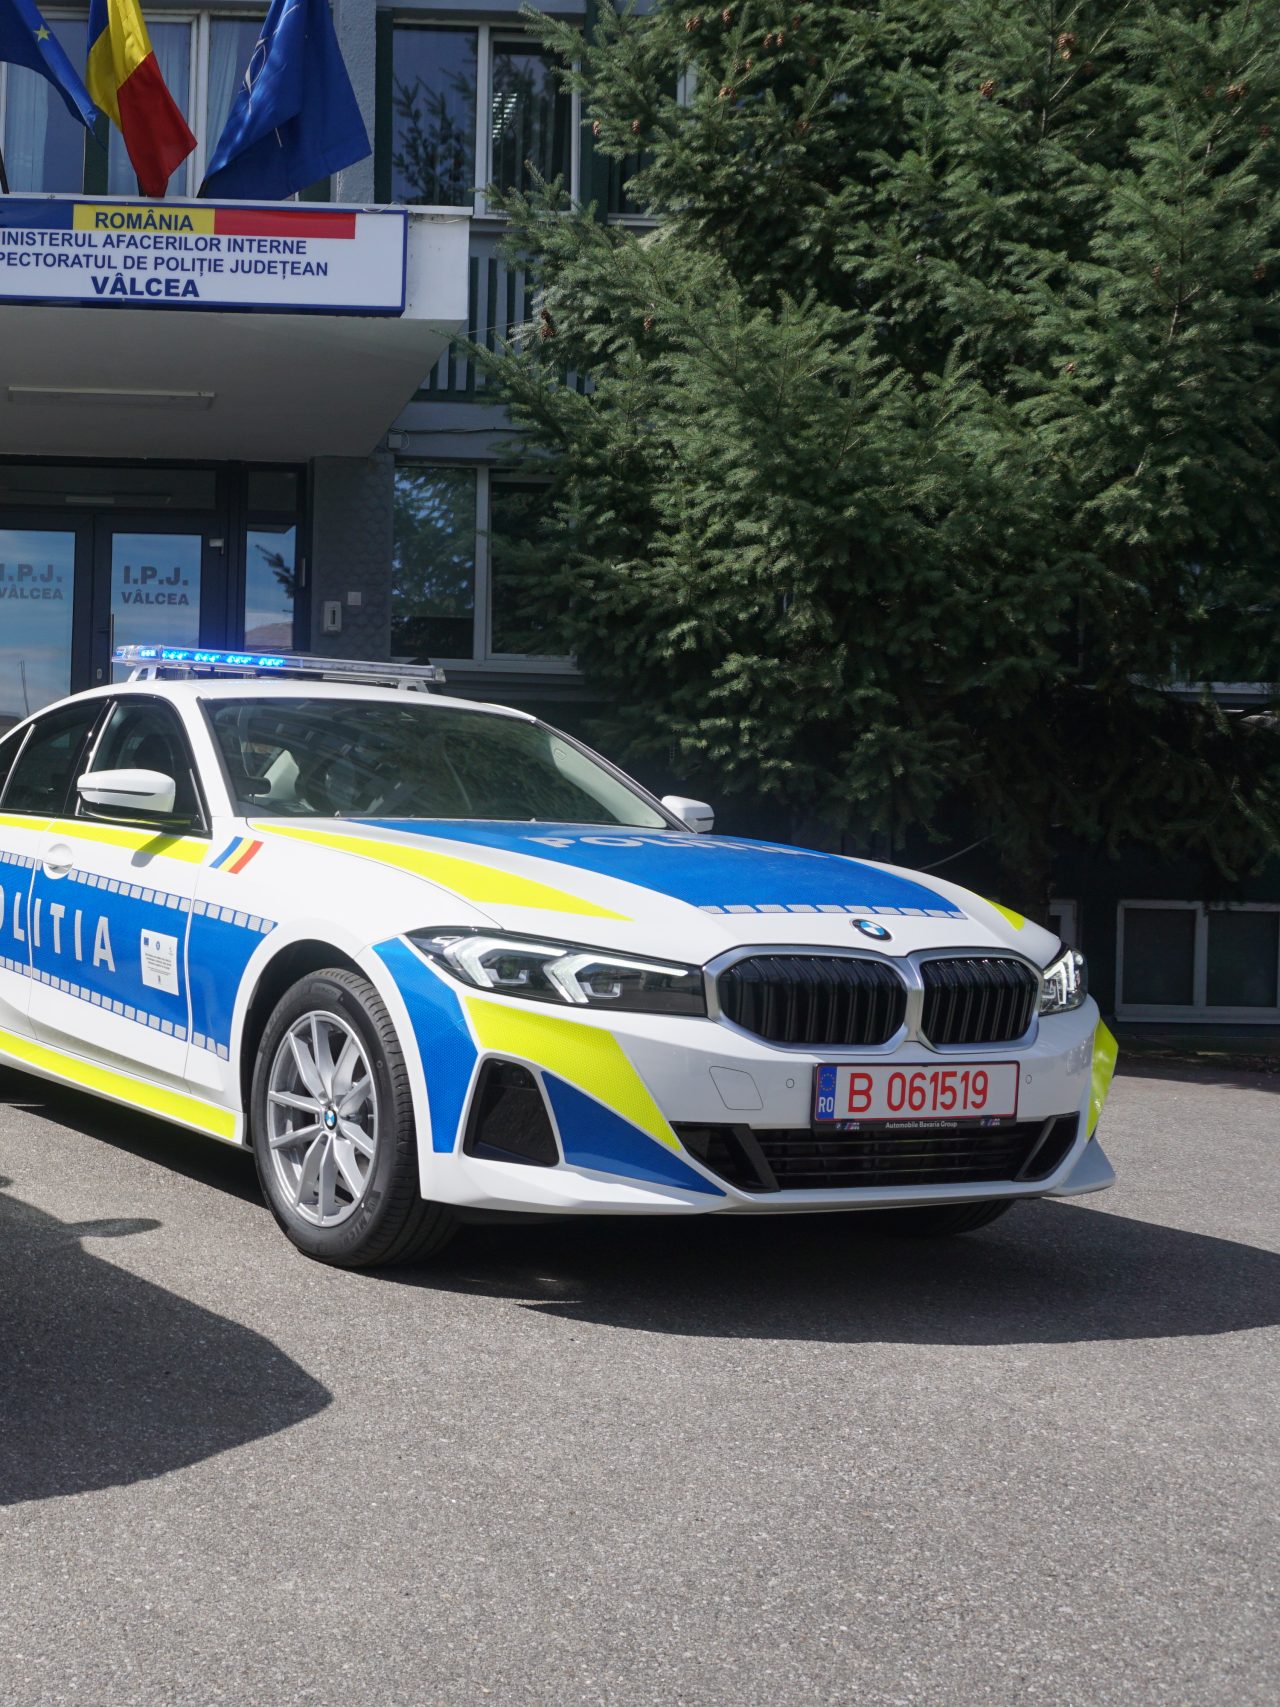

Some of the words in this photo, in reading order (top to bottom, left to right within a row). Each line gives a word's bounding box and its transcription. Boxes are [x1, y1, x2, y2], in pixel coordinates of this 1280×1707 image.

[95, 209, 194, 231] ROMÂNIA
[102, 233, 222, 252] AFACERILOR
[227, 237, 308, 255] INTERNE
[123, 255, 148, 271] DE
[154, 256, 224, 277] POLIȚIE
[230, 259, 329, 280] JUDEȚEAN
[91, 272, 200, 298] VÂLCEA
[123, 565, 189, 586] I.P.J.
[120, 588, 190, 606] VÂLCEA
[848, 1072, 873, 1113] B
[887, 1071, 988, 1111] 061519
[818, 1097, 834, 1113] RO
[885, 1121, 918, 1129] Automobile
[941, 1120, 958, 1129] Group
